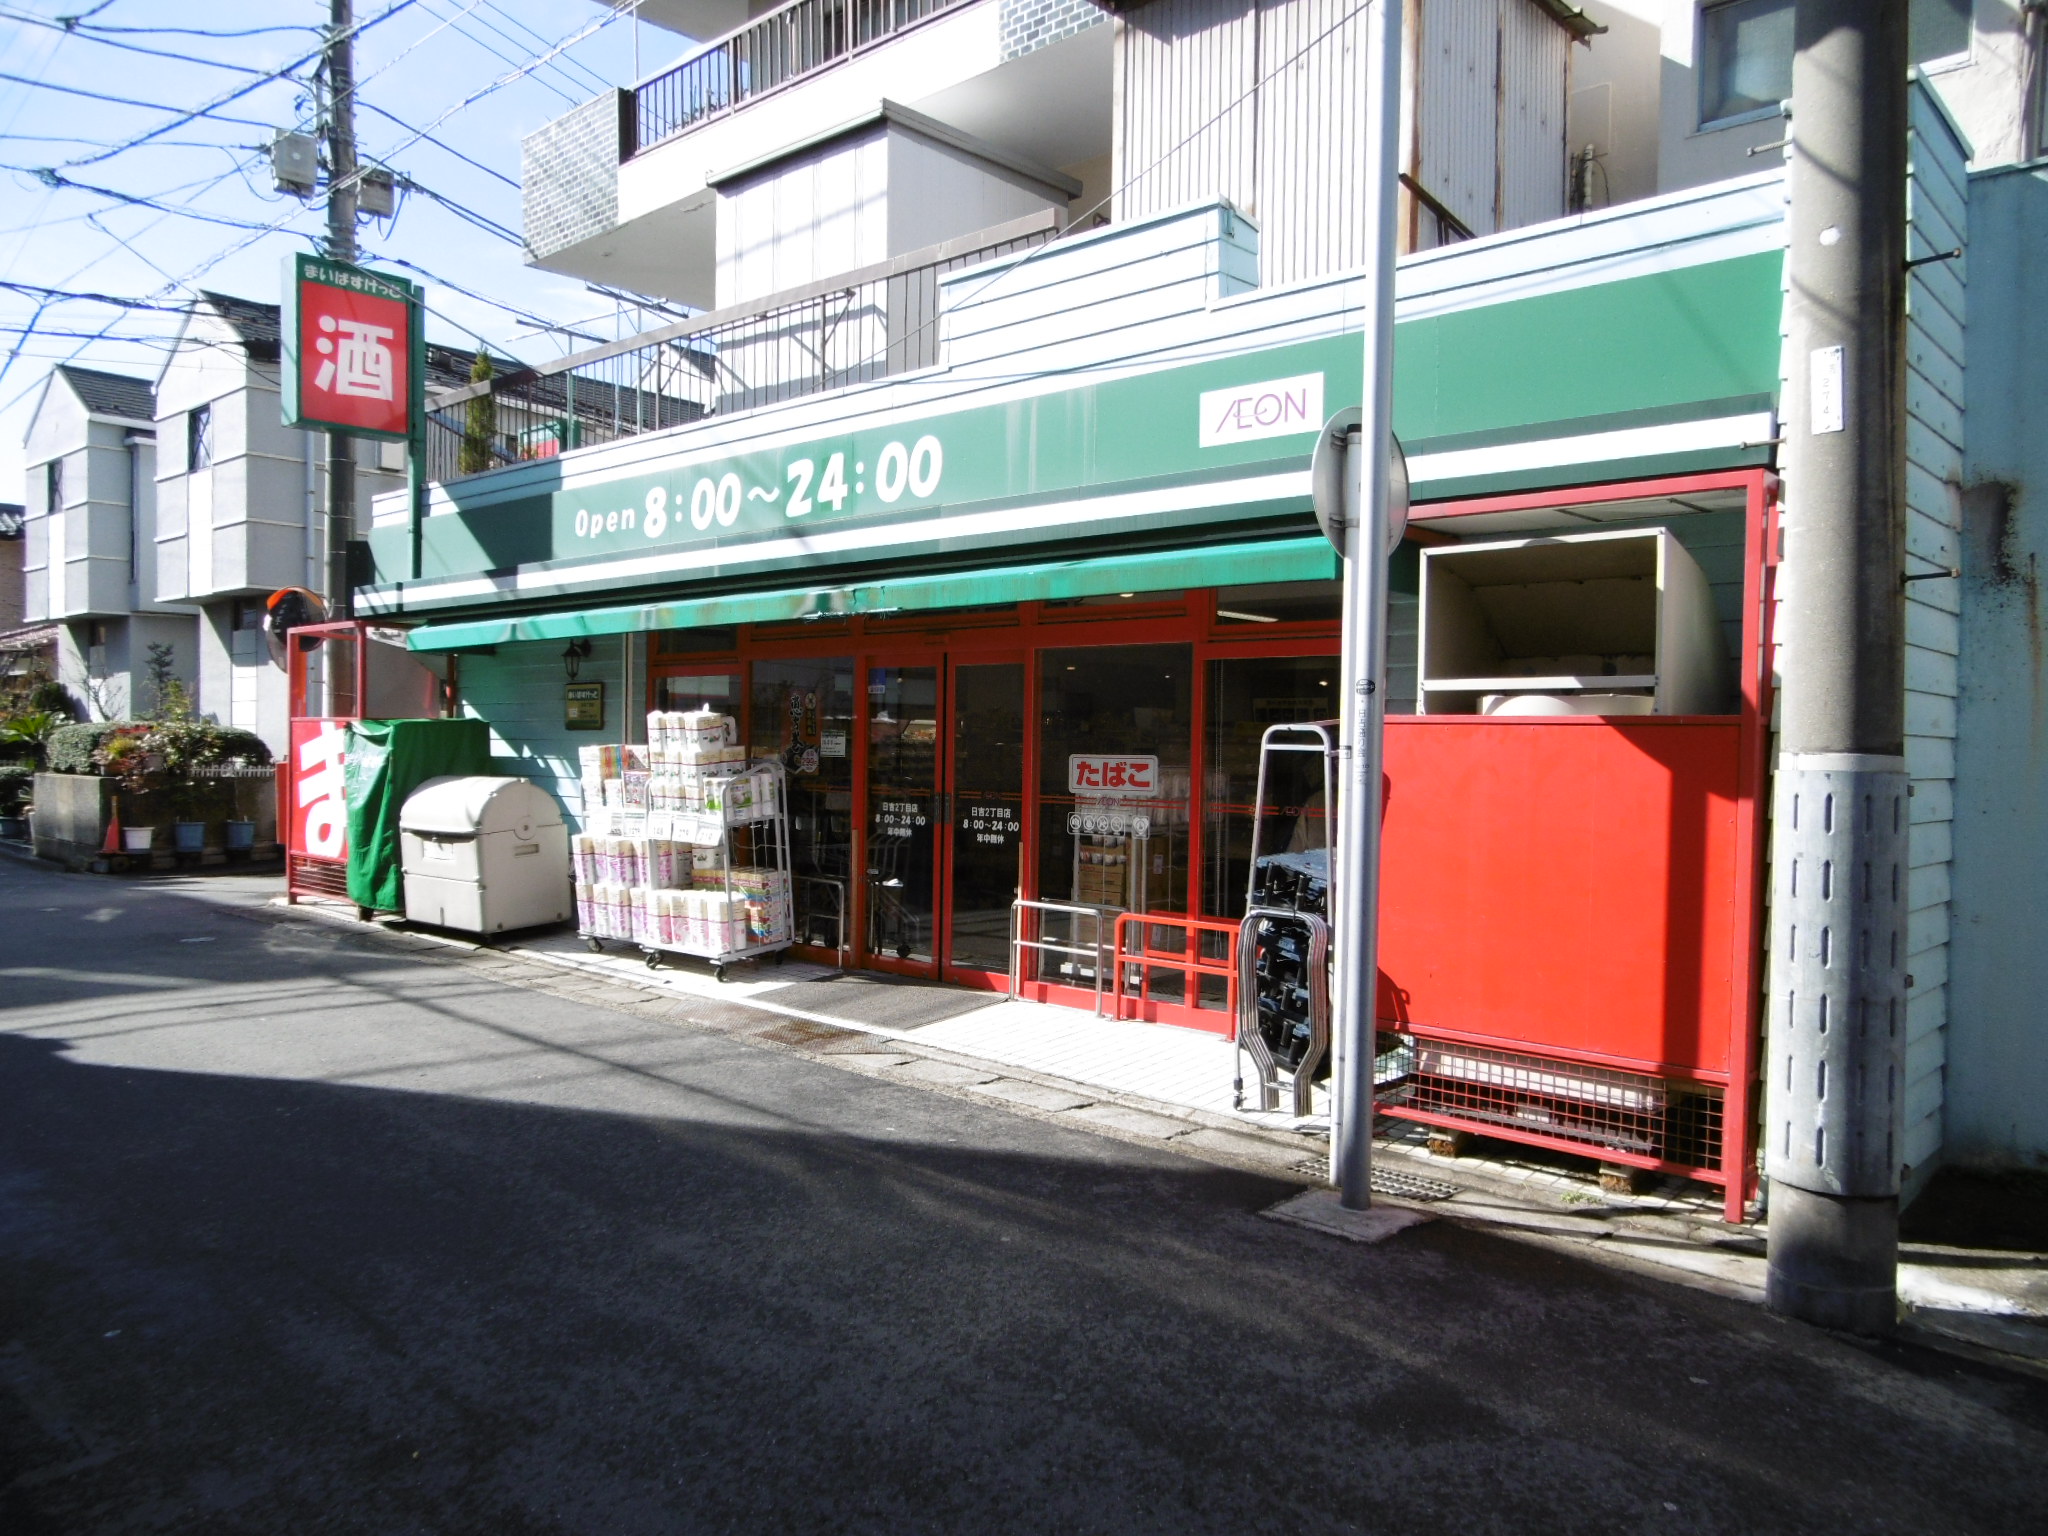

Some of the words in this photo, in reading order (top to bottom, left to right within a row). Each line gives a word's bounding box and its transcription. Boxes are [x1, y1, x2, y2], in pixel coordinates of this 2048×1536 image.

[304, 263, 402, 299] まいばすけっと
[314, 315, 394, 401] 酒
[575, 508, 635, 539] Open
[1076, 761, 1151, 788] たばこ
[882, 802, 918, 813] 日吉2丁目店
[971, 807, 1012, 818] 日吉2丁目店
[976, 833, 1004, 844] 年中無休
